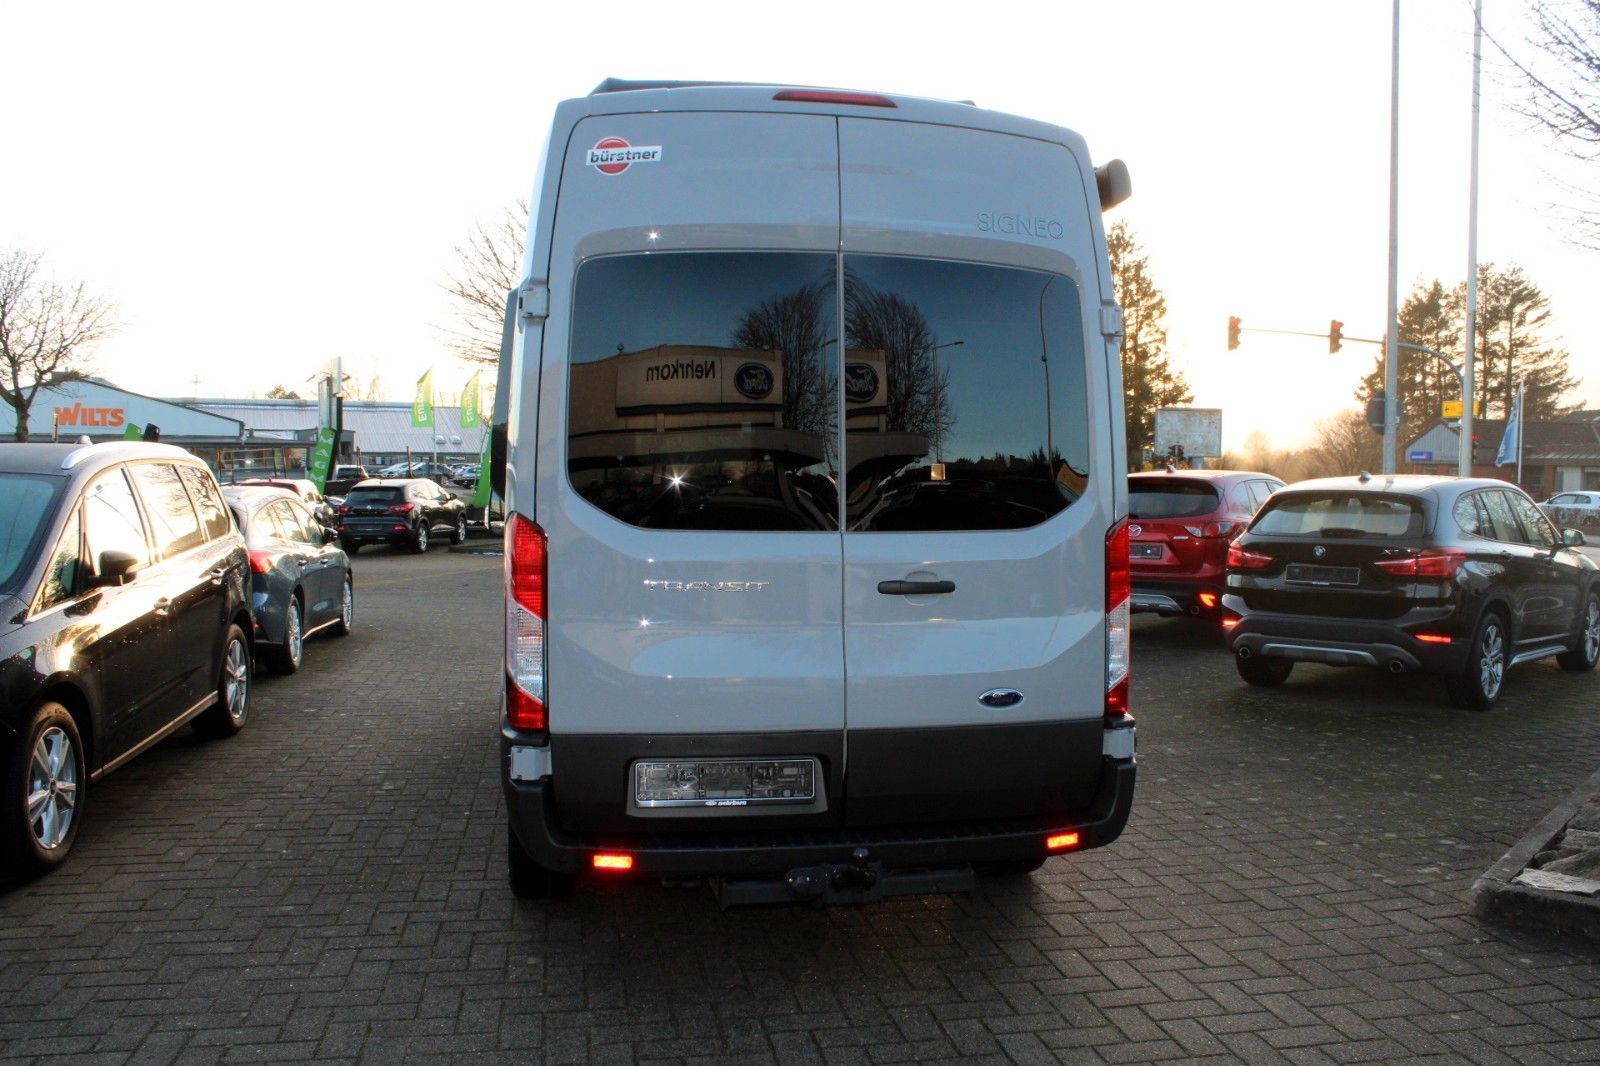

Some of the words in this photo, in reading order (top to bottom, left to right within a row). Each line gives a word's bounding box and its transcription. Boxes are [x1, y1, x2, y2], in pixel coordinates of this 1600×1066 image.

[590, 150, 659, 163] bürstner
[977, 211, 1065, 240] SIGNEO
[54, 402, 125, 427] WILTS
